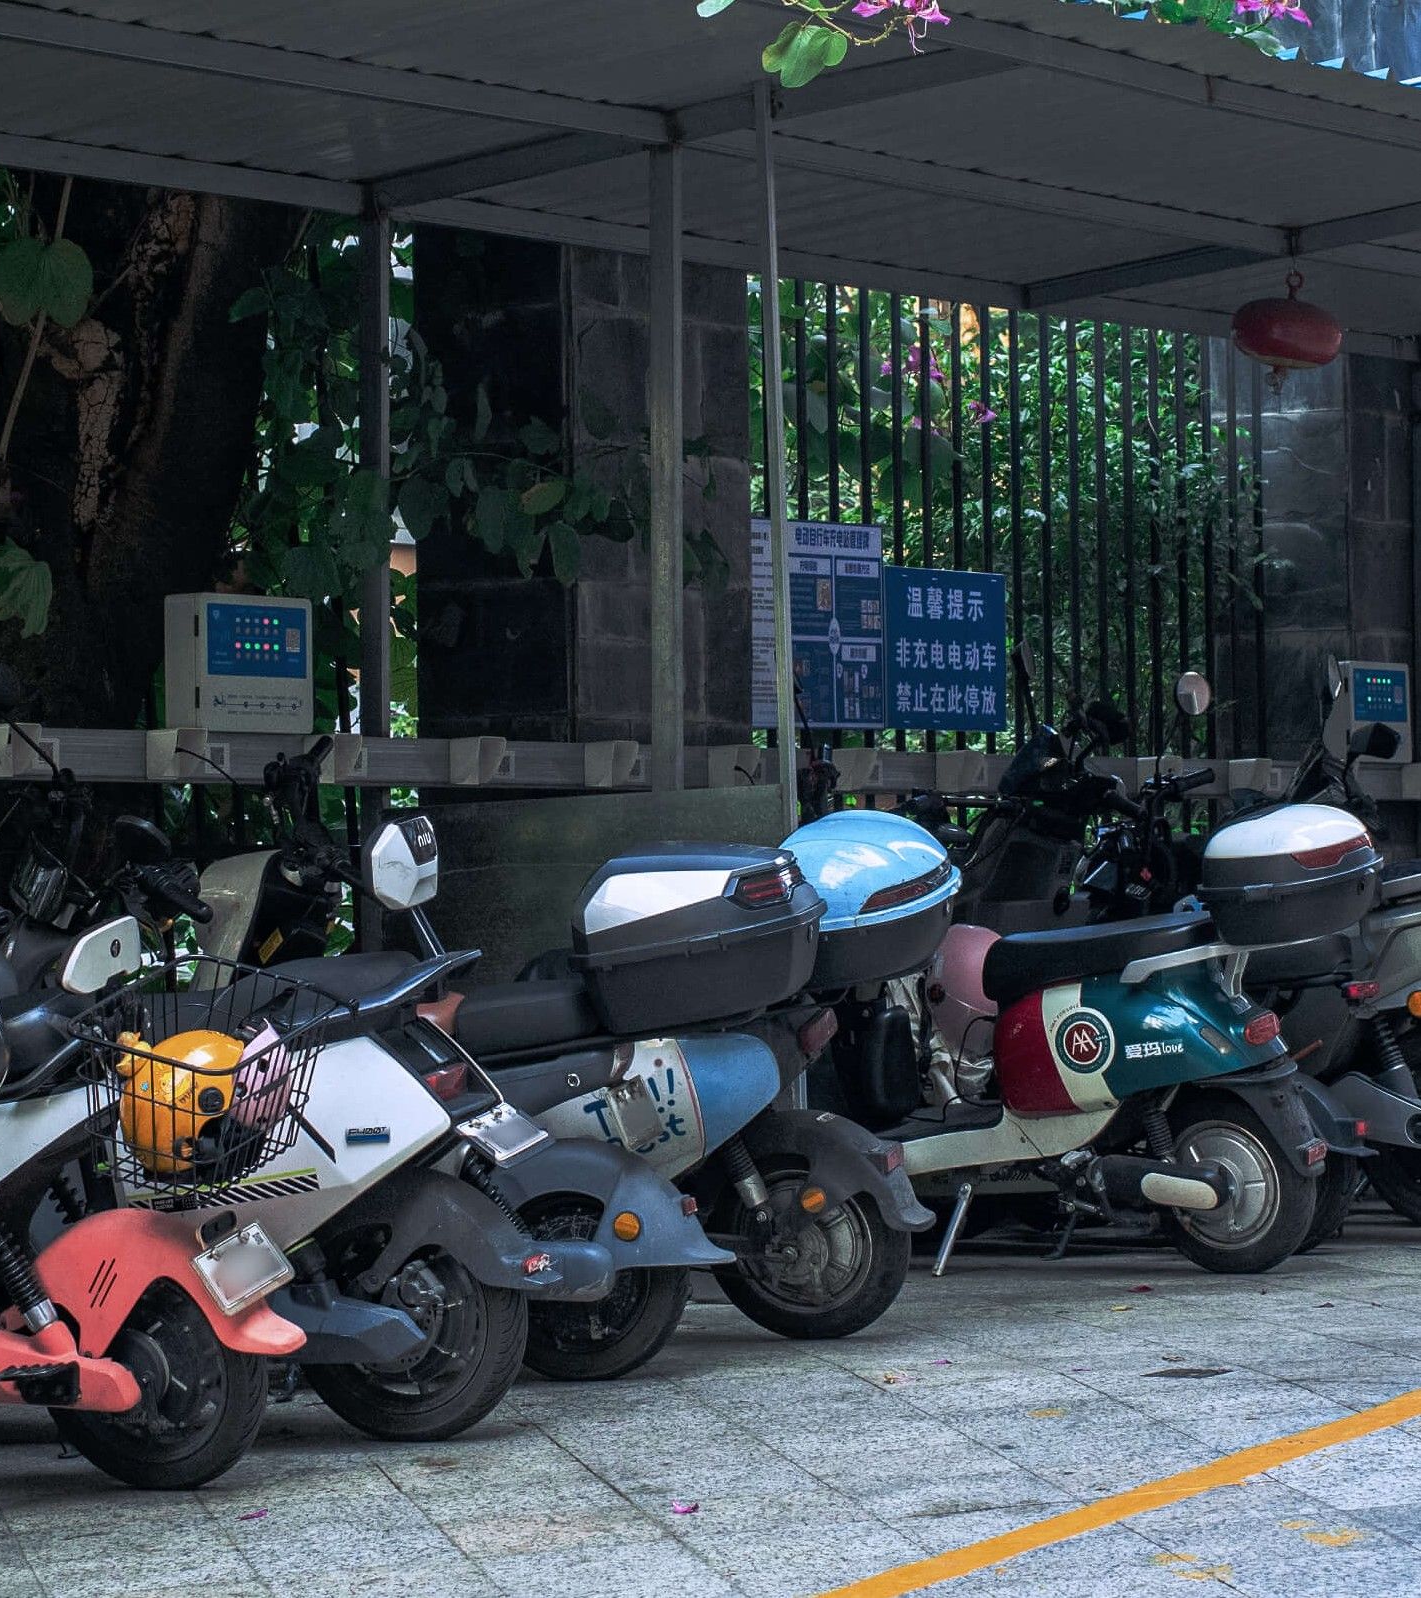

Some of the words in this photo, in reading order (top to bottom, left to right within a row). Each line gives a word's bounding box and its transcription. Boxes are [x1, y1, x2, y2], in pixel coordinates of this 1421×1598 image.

[907, 586, 984, 621] 温馨提示
[896, 637, 996, 671] 非充电电动车
[896, 681, 996, 715] 禁止在此停放
